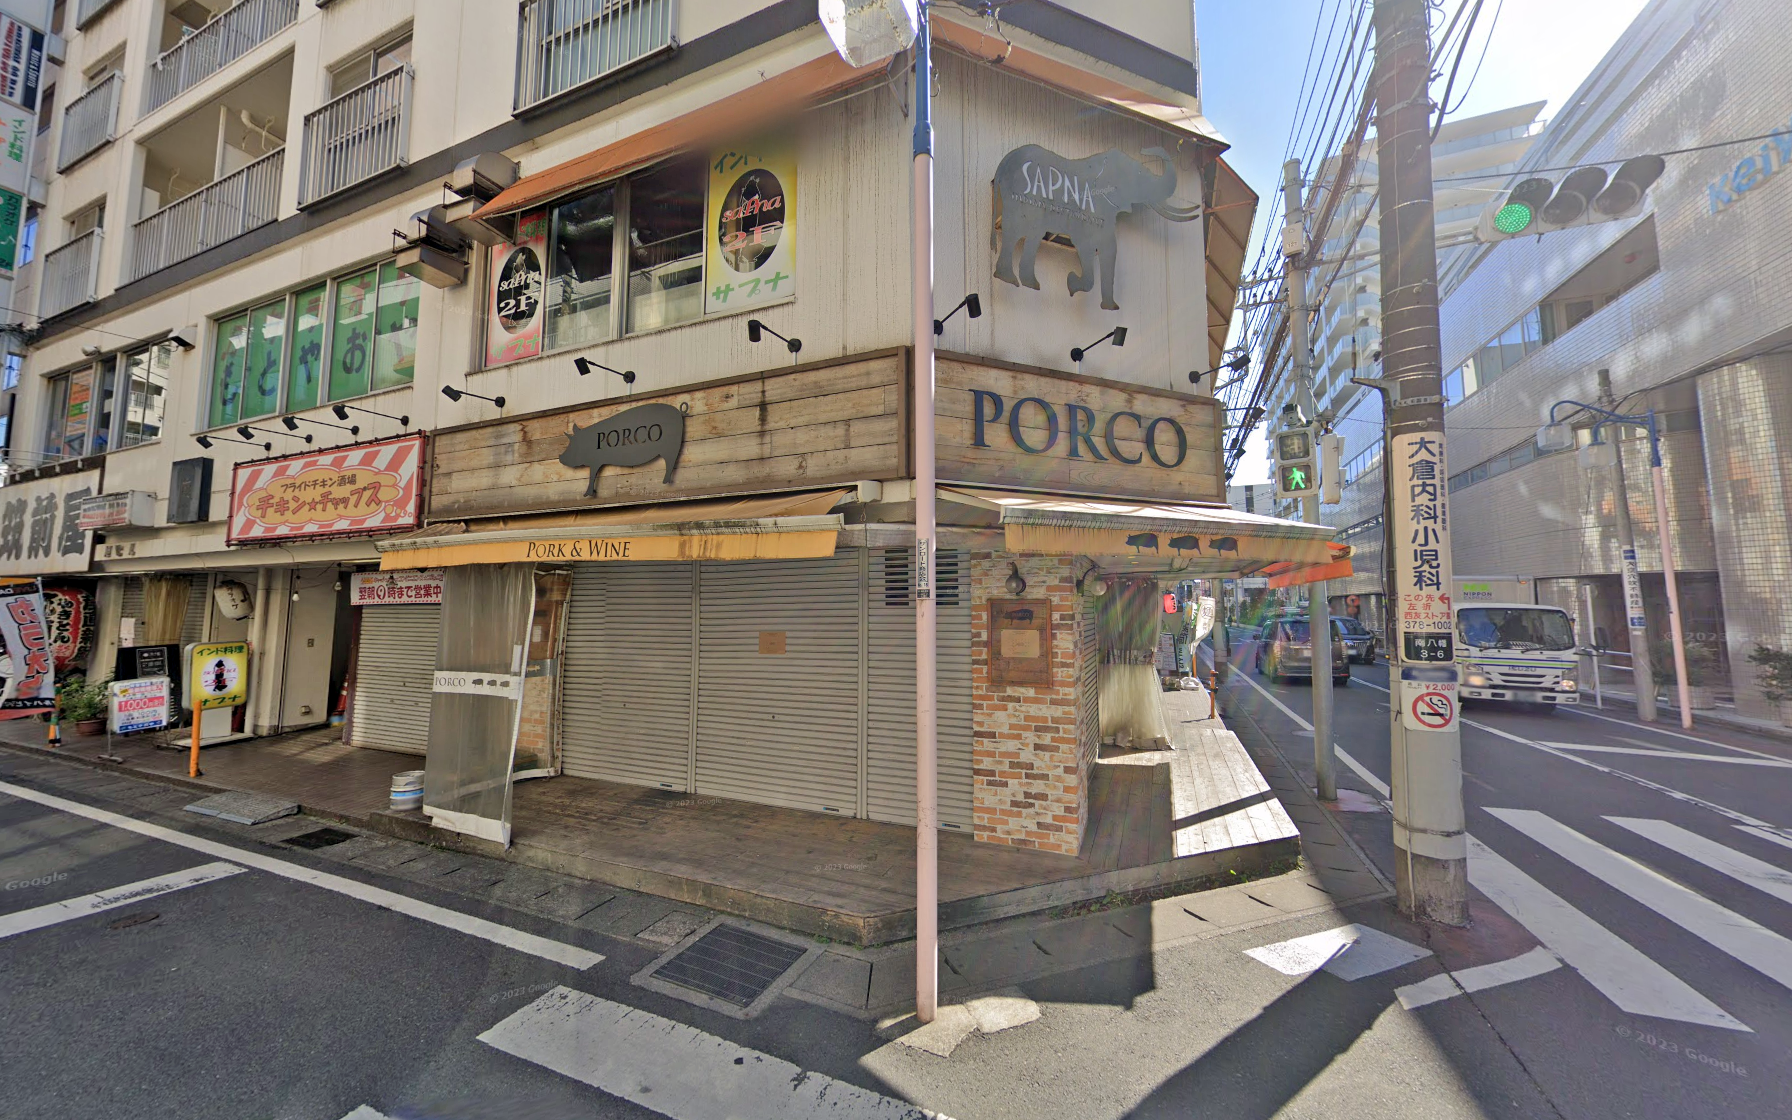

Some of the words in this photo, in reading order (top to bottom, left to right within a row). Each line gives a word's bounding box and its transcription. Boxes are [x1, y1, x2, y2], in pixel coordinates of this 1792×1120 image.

[1022, 160, 1095, 213] SAPNA
[723, 220, 784, 252] 2F
[712, 271, 789, 303] サプナ
[500, 291, 540, 317] 2F
[596, 423, 663, 450] PORCO
[968, 388, 1188, 468] PORCO
[281, 474, 357, 493] フライドチキン酒場
[1408, 437, 1442, 591] 大倉内科小児科
[526, 541, 567, 558] PORK
[571, 541, 583, 558] &
[588, 540, 631, 558] WINE
[1404, 594, 1435, 602] この先
[1404, 621, 1452, 630] 378-1002
[197, 645, 244, 656] インド料理
[1420, 649, 1444, 658] 3-6
[1508, 664, 1537, 672] ISUZU
[435, 677, 466, 687] PORCO
